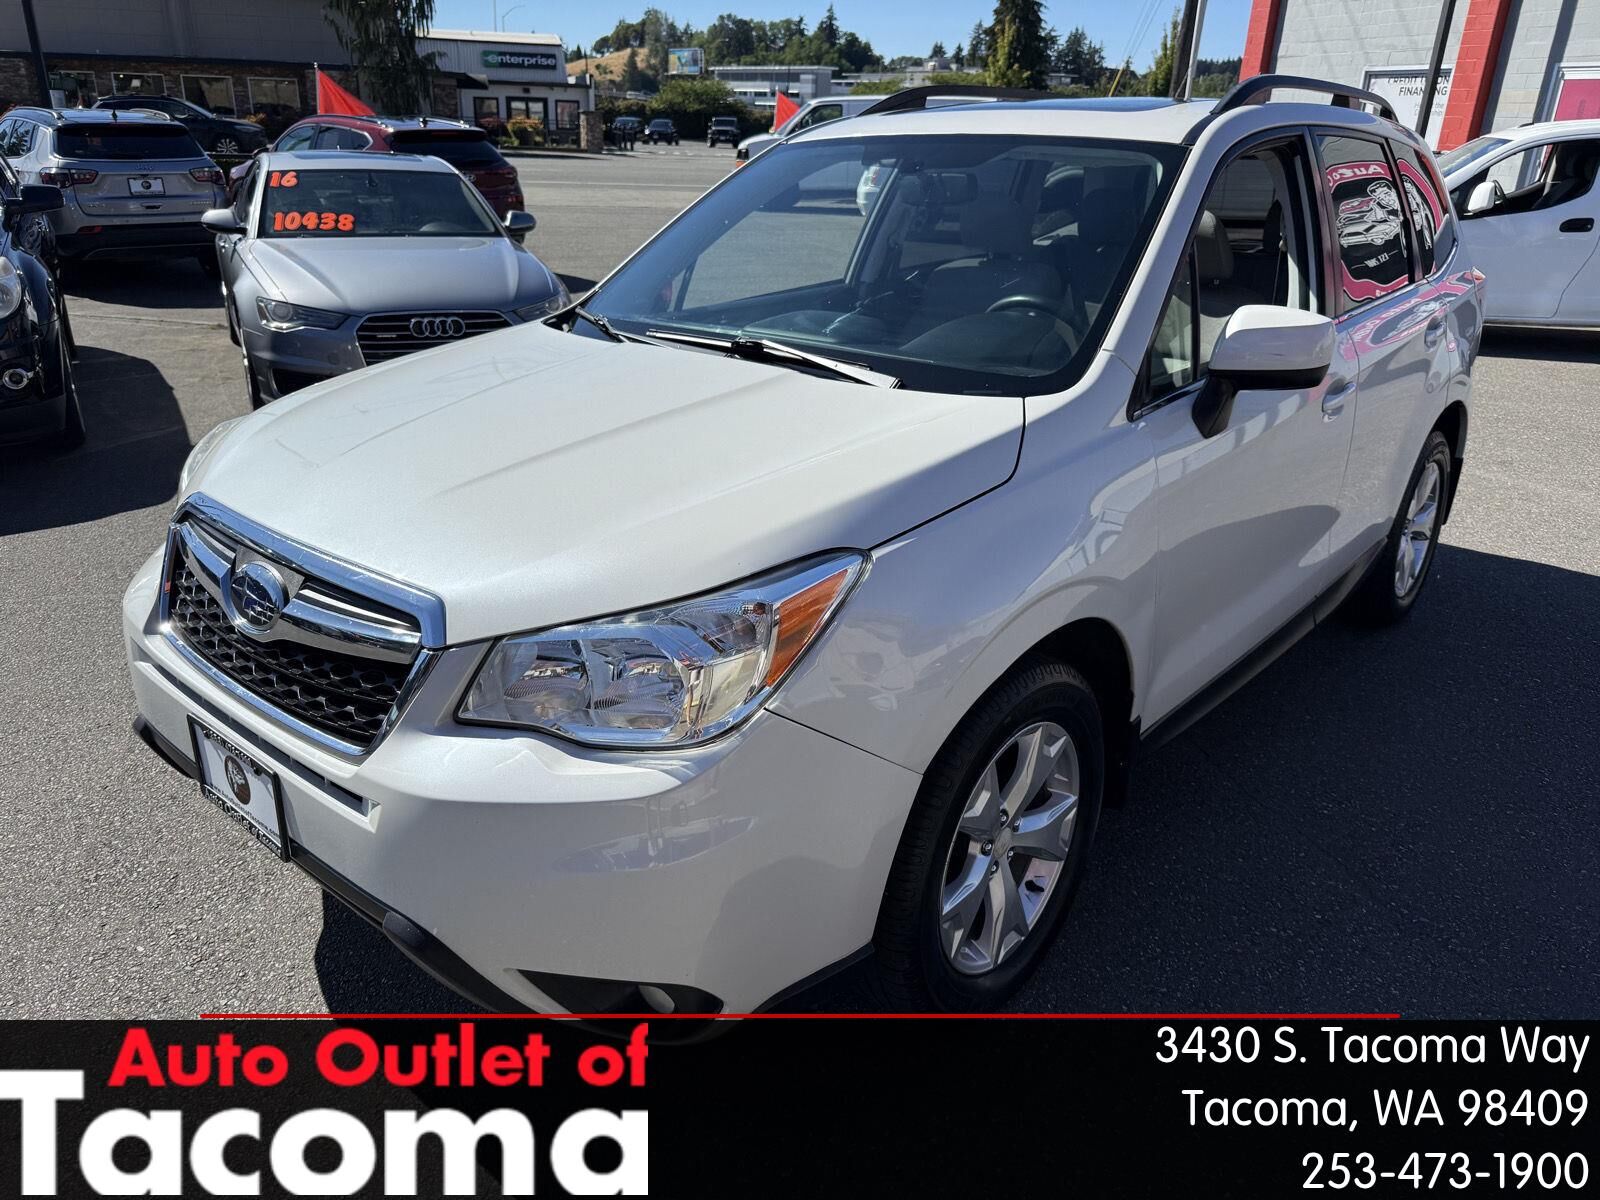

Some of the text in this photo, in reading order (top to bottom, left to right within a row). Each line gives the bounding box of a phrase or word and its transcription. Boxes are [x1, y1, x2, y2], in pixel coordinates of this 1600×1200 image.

[484, 54, 556, 67] enterprise
[1398, 86, 1448, 96] FINANNG
[269, 171, 298, 188] 16
[273, 211, 355, 231] 10438
